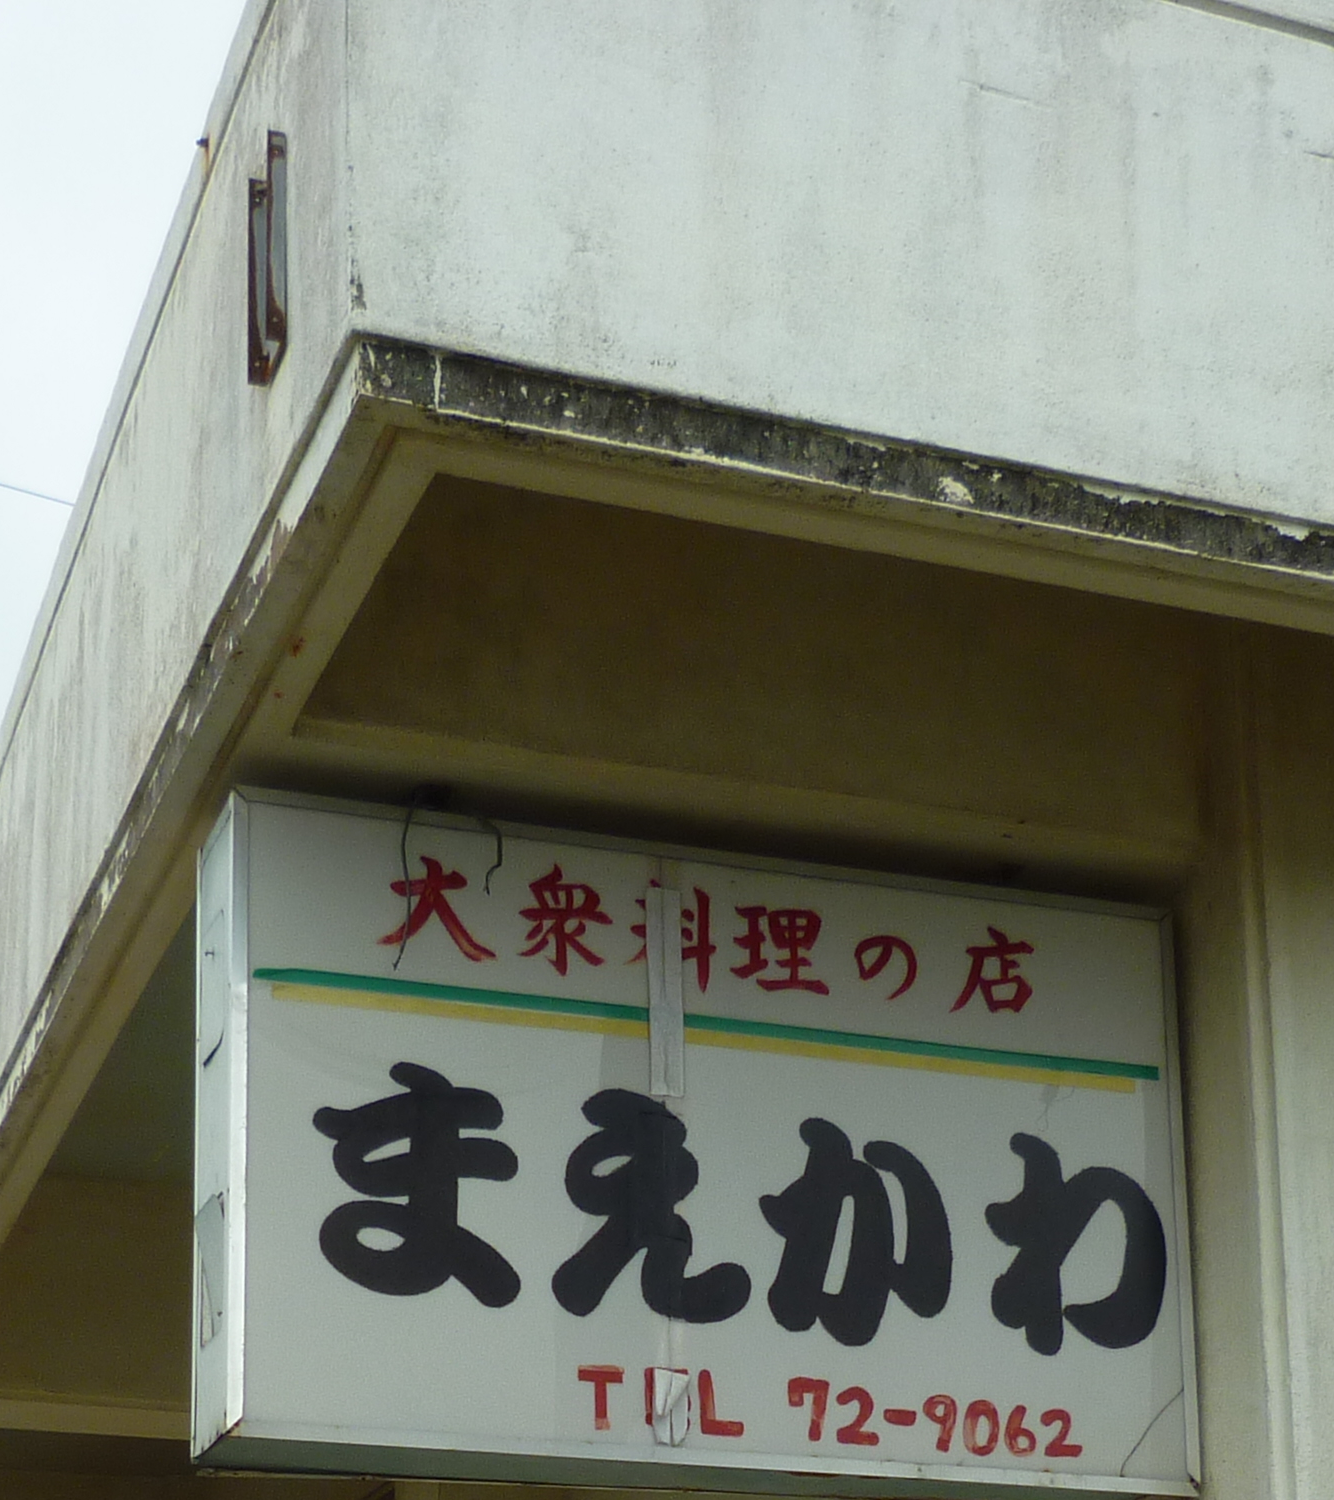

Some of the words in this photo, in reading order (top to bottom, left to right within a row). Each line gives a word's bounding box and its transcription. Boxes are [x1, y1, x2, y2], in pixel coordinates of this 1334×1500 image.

[312, 1061, 1167, 1356] まえかわ
[787, 1376, 1083, 1458] 72-9062
